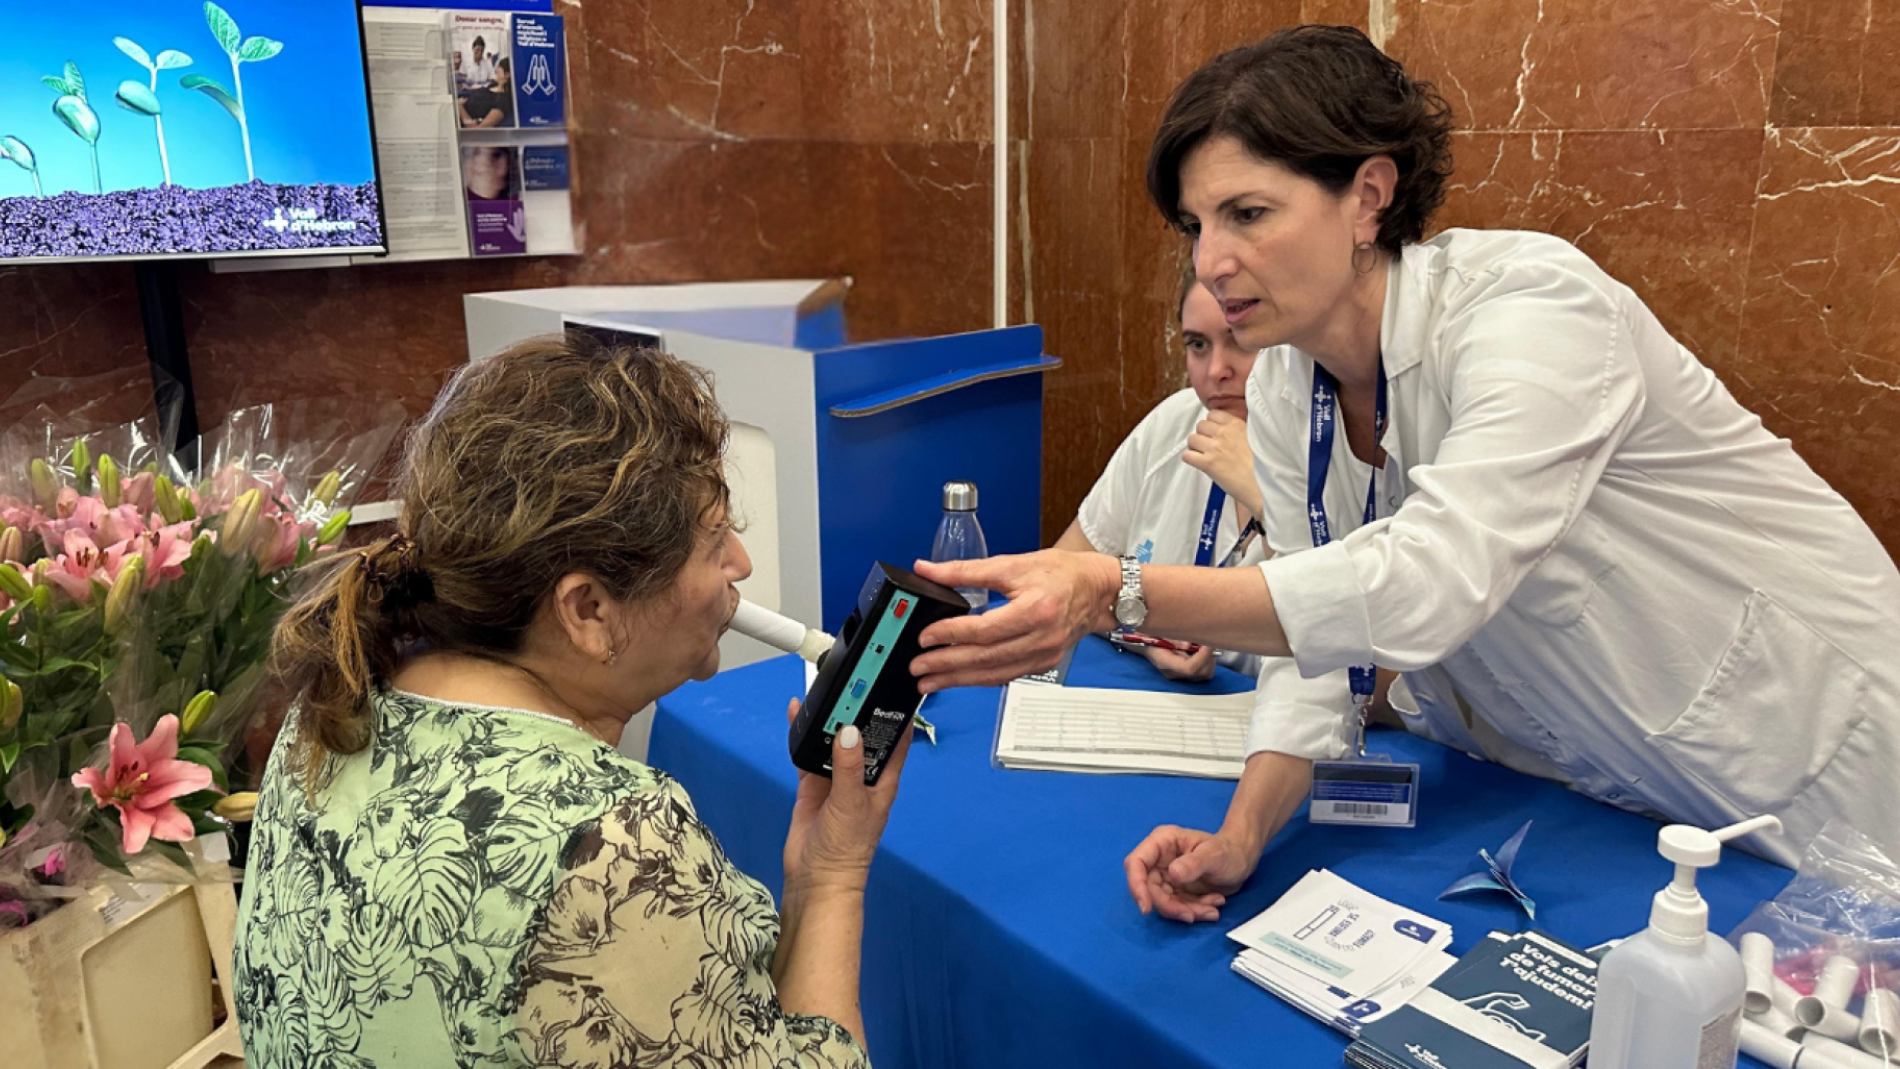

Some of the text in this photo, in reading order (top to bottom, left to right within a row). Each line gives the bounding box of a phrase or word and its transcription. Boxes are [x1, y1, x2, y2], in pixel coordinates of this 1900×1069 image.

[288, 207, 316, 219] Vall
[291, 219, 356, 231] d'Hebron
[1323, 403, 1331, 421] Vall
[1523, 943, 1560, 968] Vols
[1510, 952, 1597, 996] de fumar
